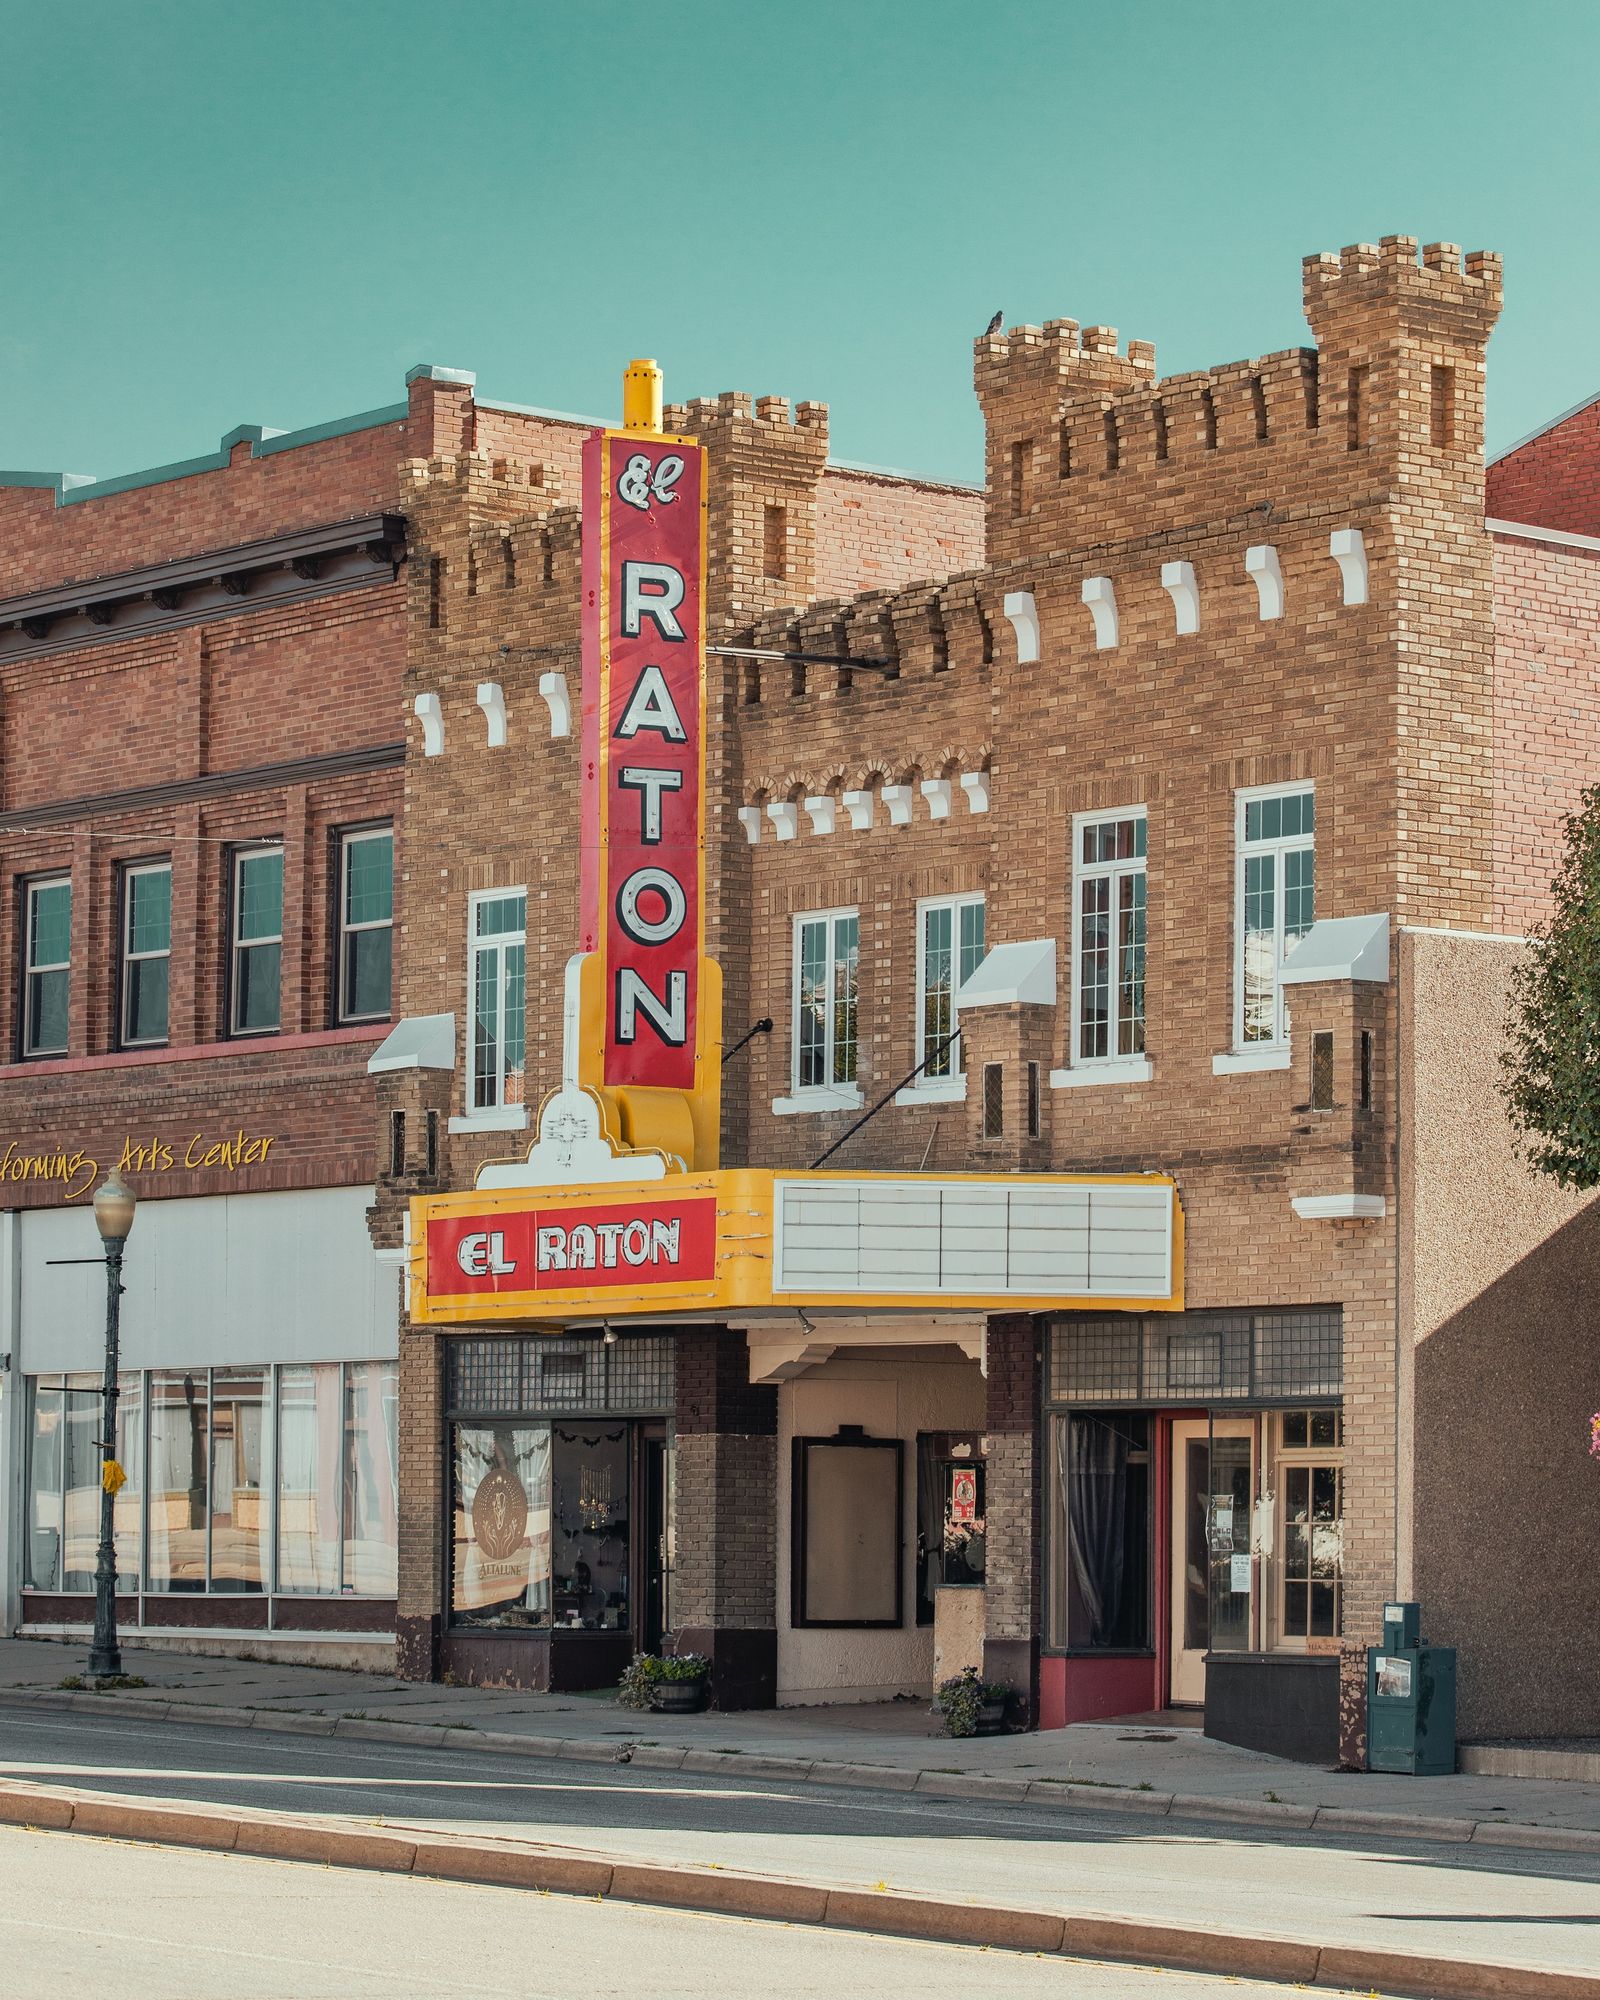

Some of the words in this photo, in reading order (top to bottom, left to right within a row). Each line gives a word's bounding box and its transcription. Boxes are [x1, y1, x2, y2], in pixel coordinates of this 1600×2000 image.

[617, 453, 685, 511] El
[612, 560, 688, 1047] RATON
[0, 1141, 98, 1199] forming
[116, 1135, 175, 1172] Arts
[185, 1129, 275, 1172] Center
[457, 1232, 518, 1276] EL
[536, 1218, 681, 1272] RATON
[479, 1562, 522, 1580] ALTALUNE
